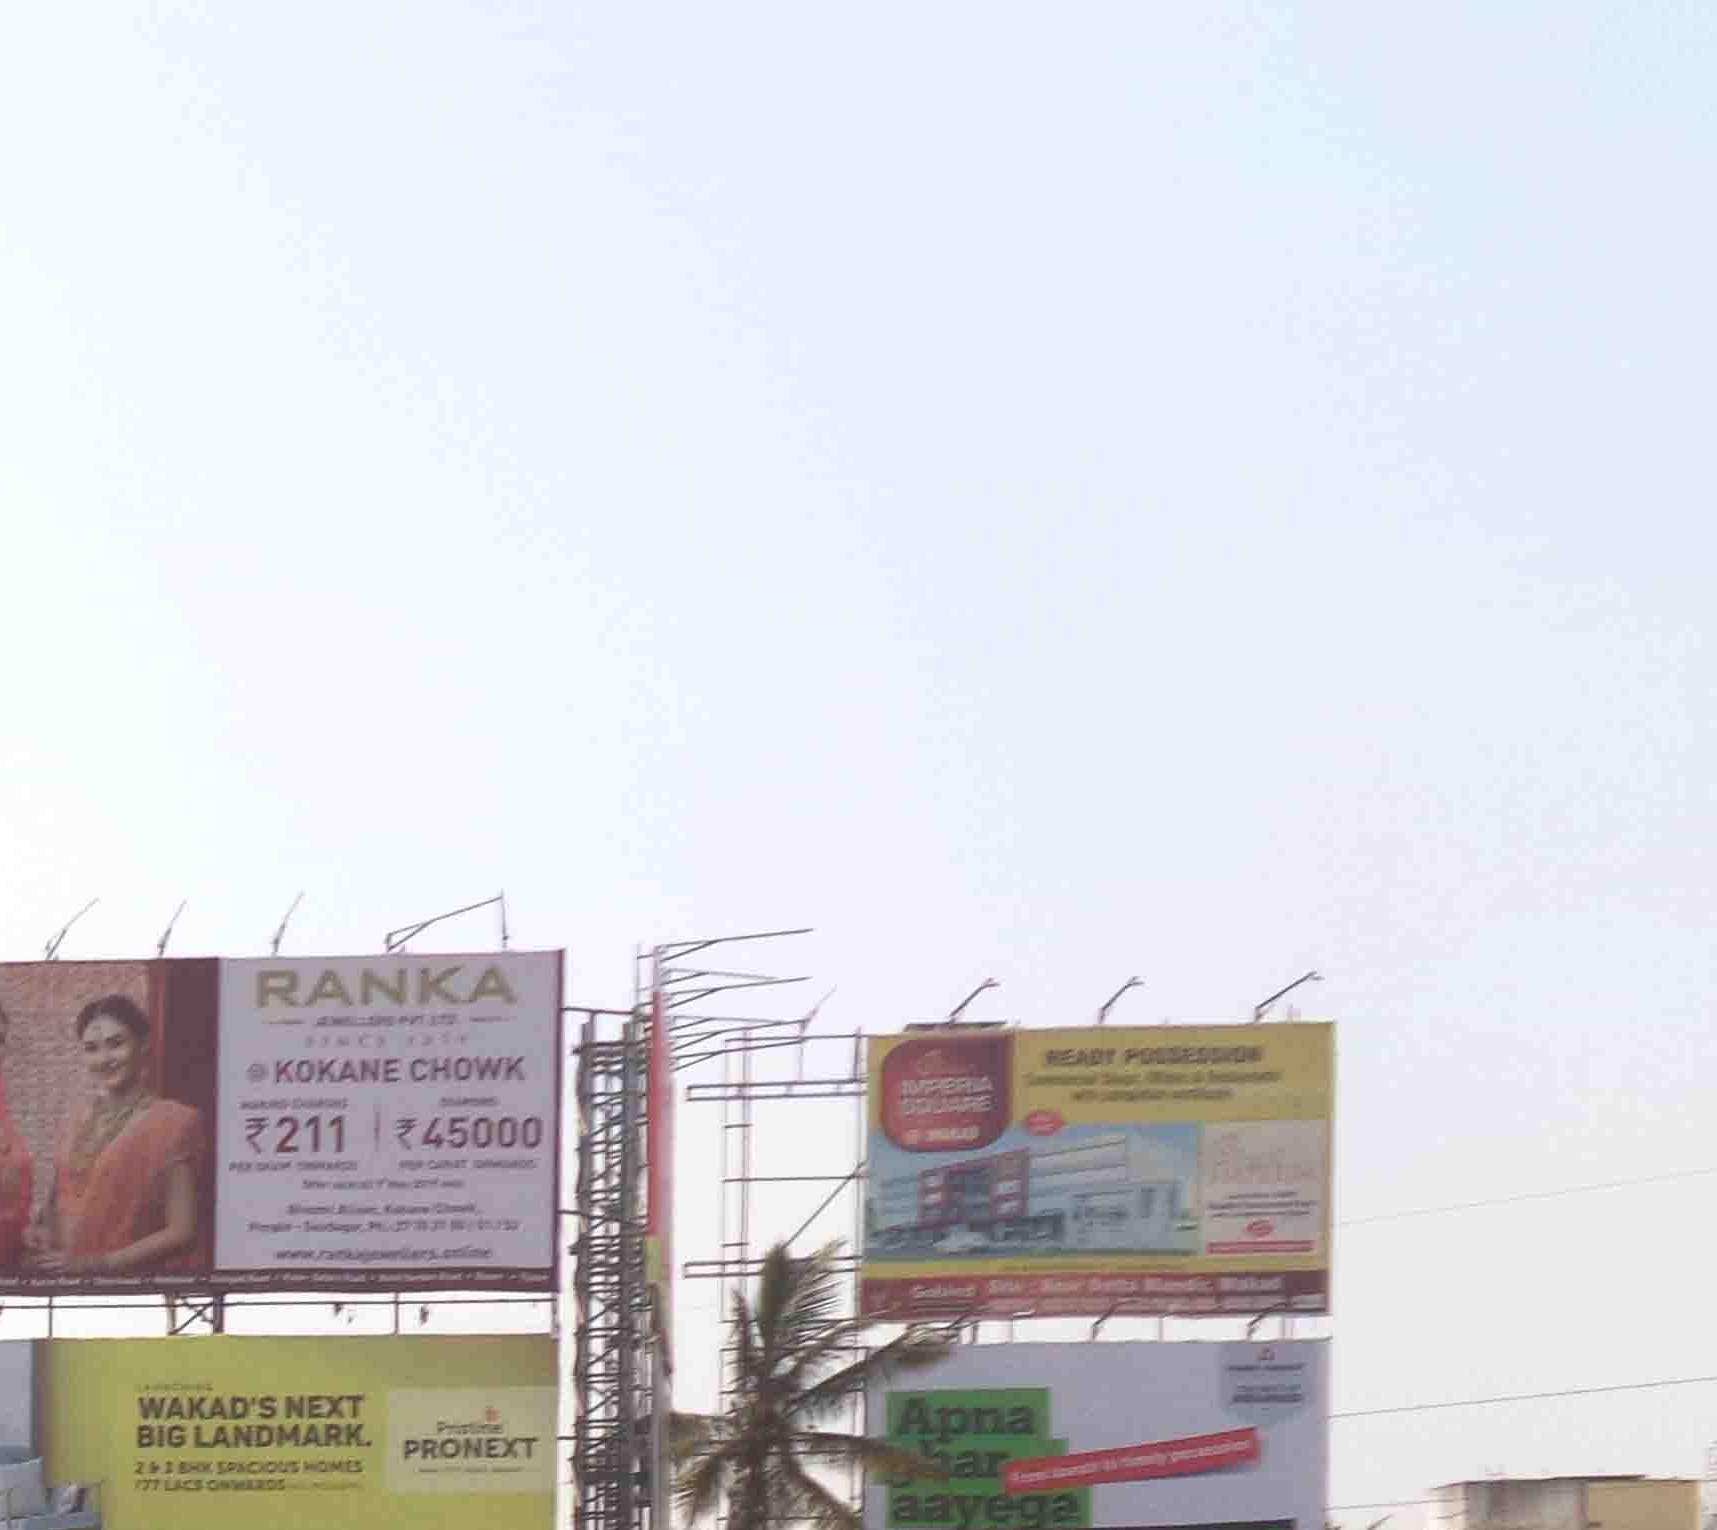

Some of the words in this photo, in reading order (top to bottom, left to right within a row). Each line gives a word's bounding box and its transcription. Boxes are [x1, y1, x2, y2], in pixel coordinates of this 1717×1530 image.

[256, 963, 518, 1008] RANKA
[275, 1057, 402, 1084] KOKANE
[409, 1055, 526, 1083] CHOWK
[137, 1396, 278, 1420] WAKAD'S
[284, 1394, 366, 1419] NEXT
[899, 1397, 1034, 1443] Apna
[137, 1424, 188, 1448] BIG
[192, 1422, 373, 1448] LANDMARK.
[404, 1437, 539, 1461] PRONEXT
[216, 1460, 300, 1474] SPACIOUS
[304, 1460, 364, 1473] HOMES
[891, 1494, 1081, 1530] aayega
